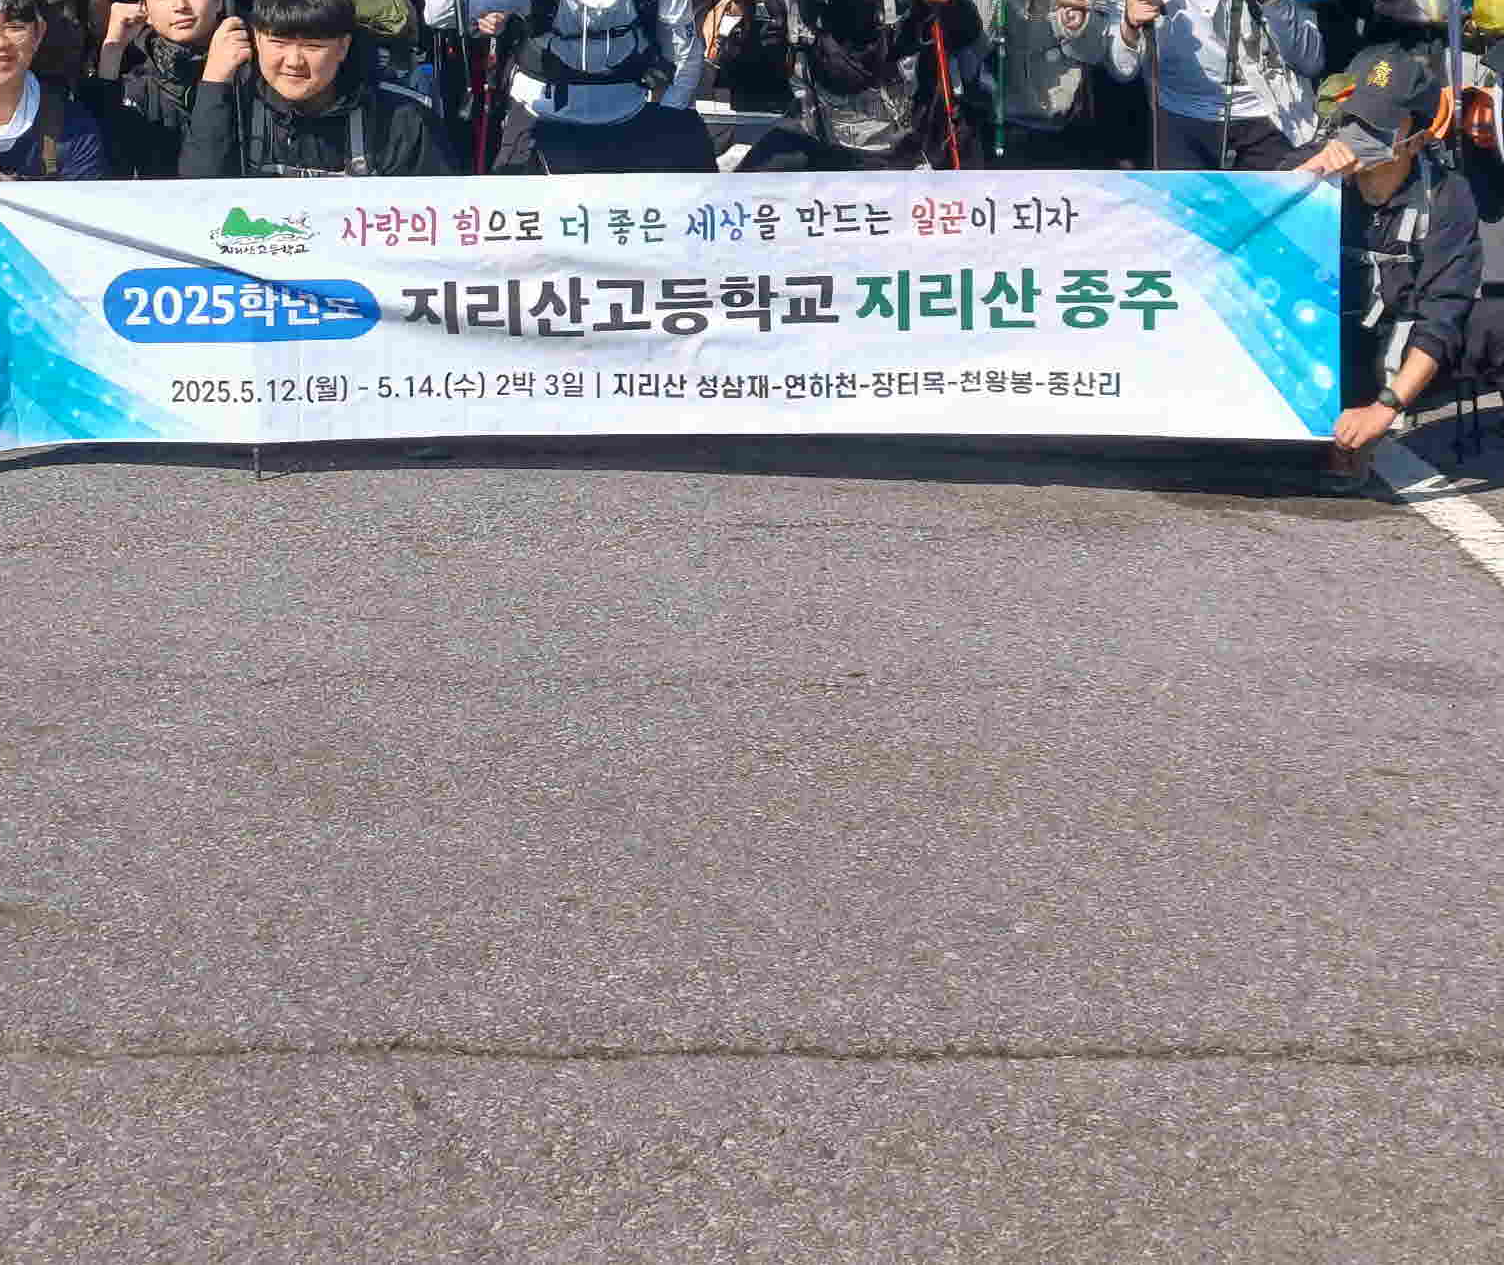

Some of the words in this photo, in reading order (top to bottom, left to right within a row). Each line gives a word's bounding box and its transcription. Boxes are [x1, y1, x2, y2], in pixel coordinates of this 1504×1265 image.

[341, 205, 438, 248] 사랑의
[452, 207, 544, 243] 힘으로
[558, 204, 590, 245] 더
[608, 204, 668, 245] 좋은
[685, 201, 782, 242] 세상을
[798, 199, 893, 238] 만드는
[911, 198, 997, 237] 일꾼이
[1012, 196, 1080, 235] 되자
[123, 283, 364, 327] 2025학년도
[401, 274, 840, 337] 지리산고등학교
[855, 268, 1042, 331] 지리산
[1055, 269, 1179, 331] 종주
[171, 375, 348, 404] 2025.5.12.(월)
[377, 372, 486, 401] 5.14.(수)
[496, 372, 537, 398] 2박
[544, 371, 585, 398] 3일
[612, 373, 687, 399] 지리산
[696, 370, 1122, 399] 성삼재-연하천-장터목-천왕봉-중산리
